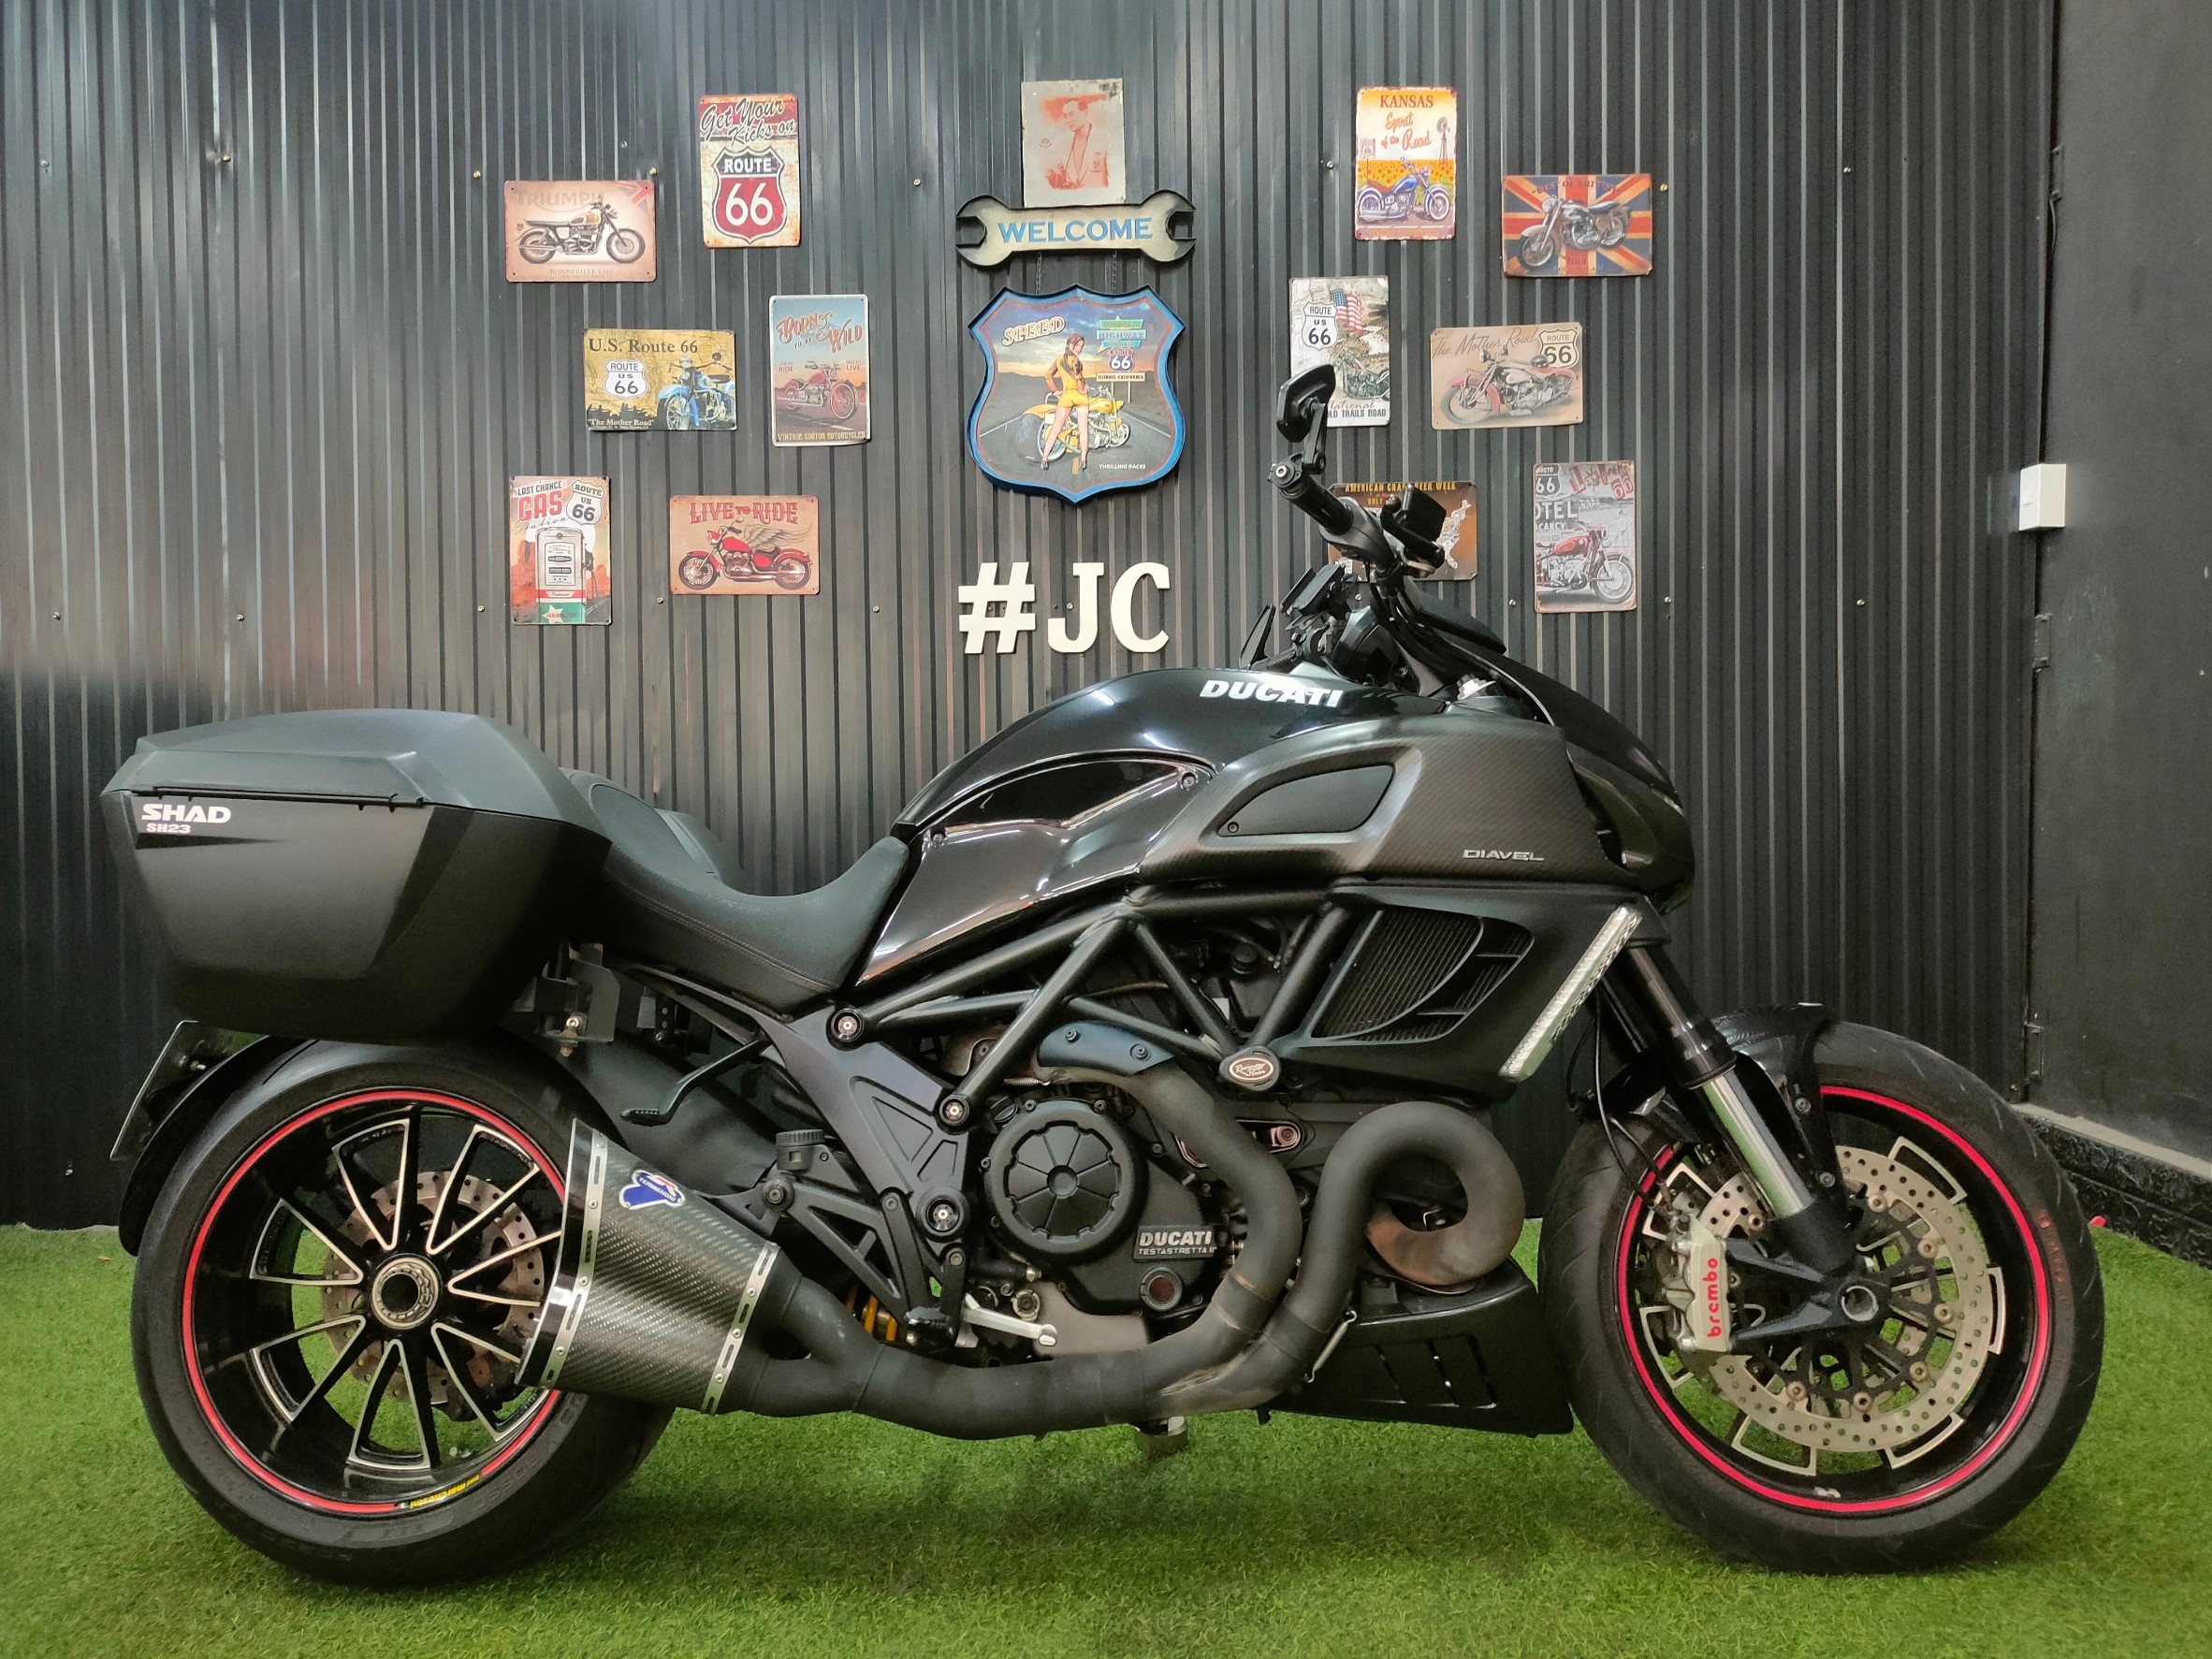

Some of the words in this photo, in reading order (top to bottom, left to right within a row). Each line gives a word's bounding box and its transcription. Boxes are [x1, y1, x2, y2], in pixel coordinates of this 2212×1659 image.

[1379, 95, 1434, 109] KANSAS
[701, 105, 733, 141] Get
[735, 97, 784, 127] Your
[727, 121, 773, 147] Kicks
[778, 121, 795, 135] on
[724, 157, 773, 174] ROUTE
[725, 182, 774, 226] 66
[997, 216, 1154, 243] WELCOME
[1309, 306, 1332, 315] ROUTE
[1001, 316, 1066, 347] SPEED
[1308, 327, 1332, 345] 66
[1546, 334, 1569, 342] ROUTE
[589, 338, 623, 353] U.S.
[628, 340, 676, 354] Route
[680, 340, 698, 354] 66
[1433, 337, 1451, 359] The
[1455, 332, 1501, 357] Mother
[1506, 327, 1539, 349] Road
[1111, 356, 1130, 370] 66
[1544, 344, 1572, 365] 66
[610, 362, 638, 371] ROUTE
[614, 380, 639, 395] 66
[1342, 408, 1365, 418] TRAILS
[1367, 408, 1387, 417] ROAD
[606, 418, 633, 427] Mother
[517, 487, 534, 496] LAST
[536, 480, 562, 493] CHANCE
[575, 484, 603, 498] ROUTE
[1345, 483, 1383, 493] AMERICAN
[1435, 482, 1456, 491] WEEK
[1535, 476, 1556, 494] 66
[518, 490, 563, 522] GAS
[580, 497, 591, 505] US
[1368, 498, 1383, 506] ONLY
[572, 503, 596, 522] 66
[690, 502, 734, 525] LIVE
[735, 506, 750, 515] TO
[752, 502, 798, 526] RIDE
[515, 515, 570, 535] Station
[1200, 679, 1344, 708] DUCATI
[141, 803, 232, 823] SHAD
[146, 822, 192, 834] SH23
[1463, 849, 1545, 862] DIAVEL
[638, 1176, 677, 1202] TERMIGNONI
[1139, 1230, 1213, 1247] DUCATI
[1138, 1247, 1207, 1256] TESTASTRETTA
[1702, 1258, 1723, 1338] brembo
